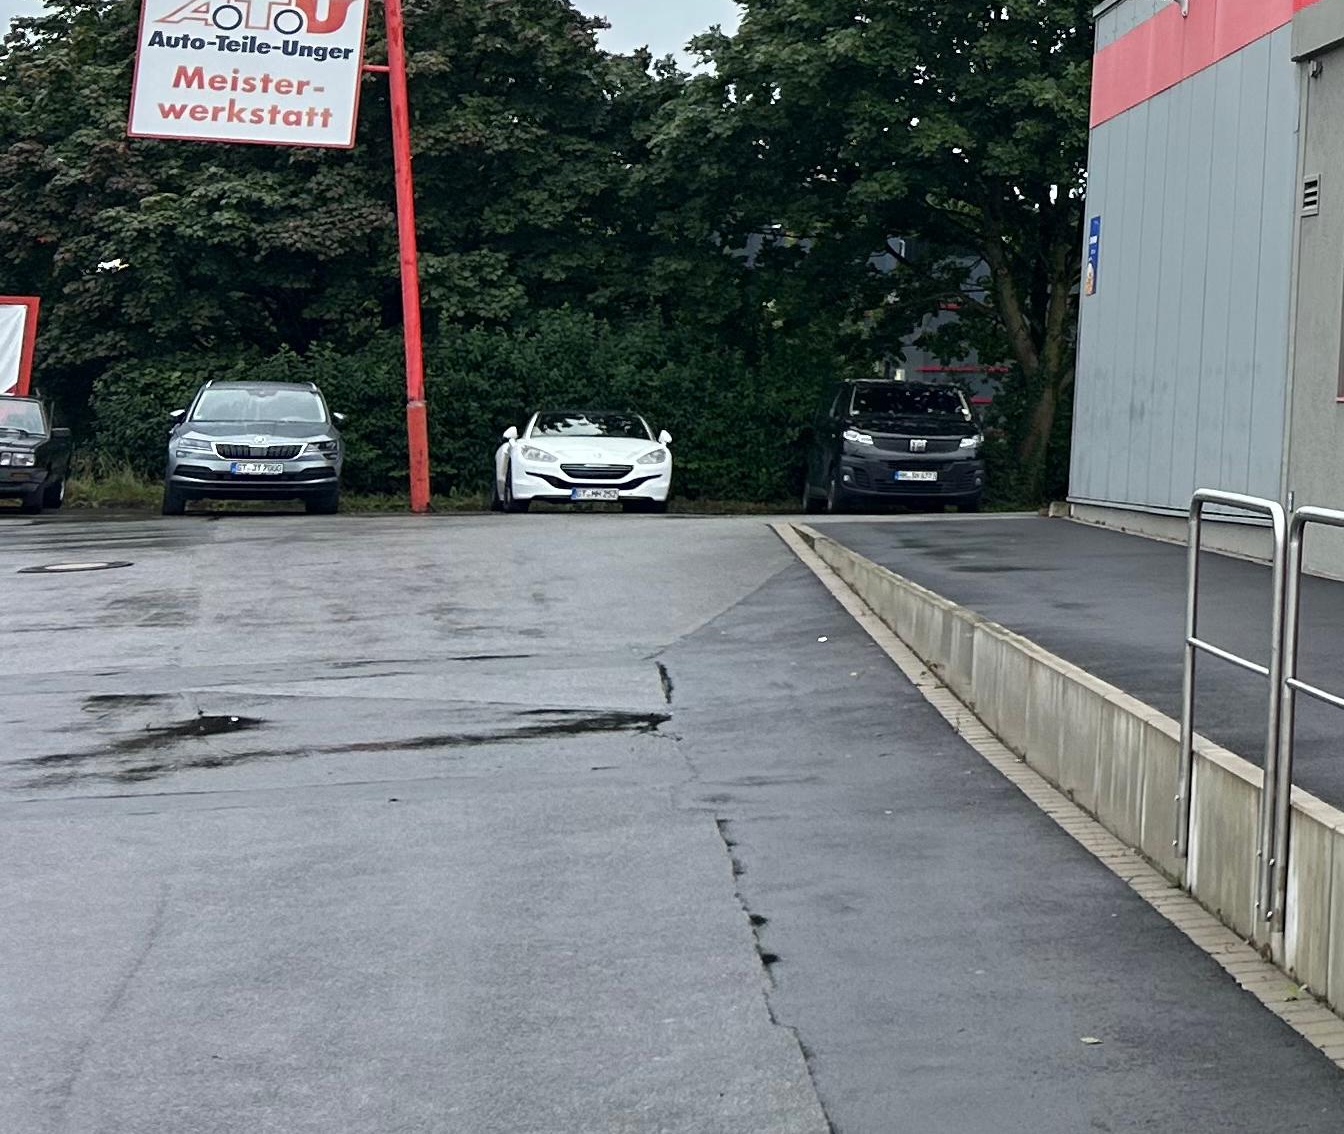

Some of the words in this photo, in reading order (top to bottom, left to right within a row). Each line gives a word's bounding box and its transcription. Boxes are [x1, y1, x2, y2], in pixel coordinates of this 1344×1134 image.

[148, 31, 354, 62] Auto-Teile-Unger
[172, 65, 325, 96] Meister-
[157, 98, 333, 128] werkstatt
